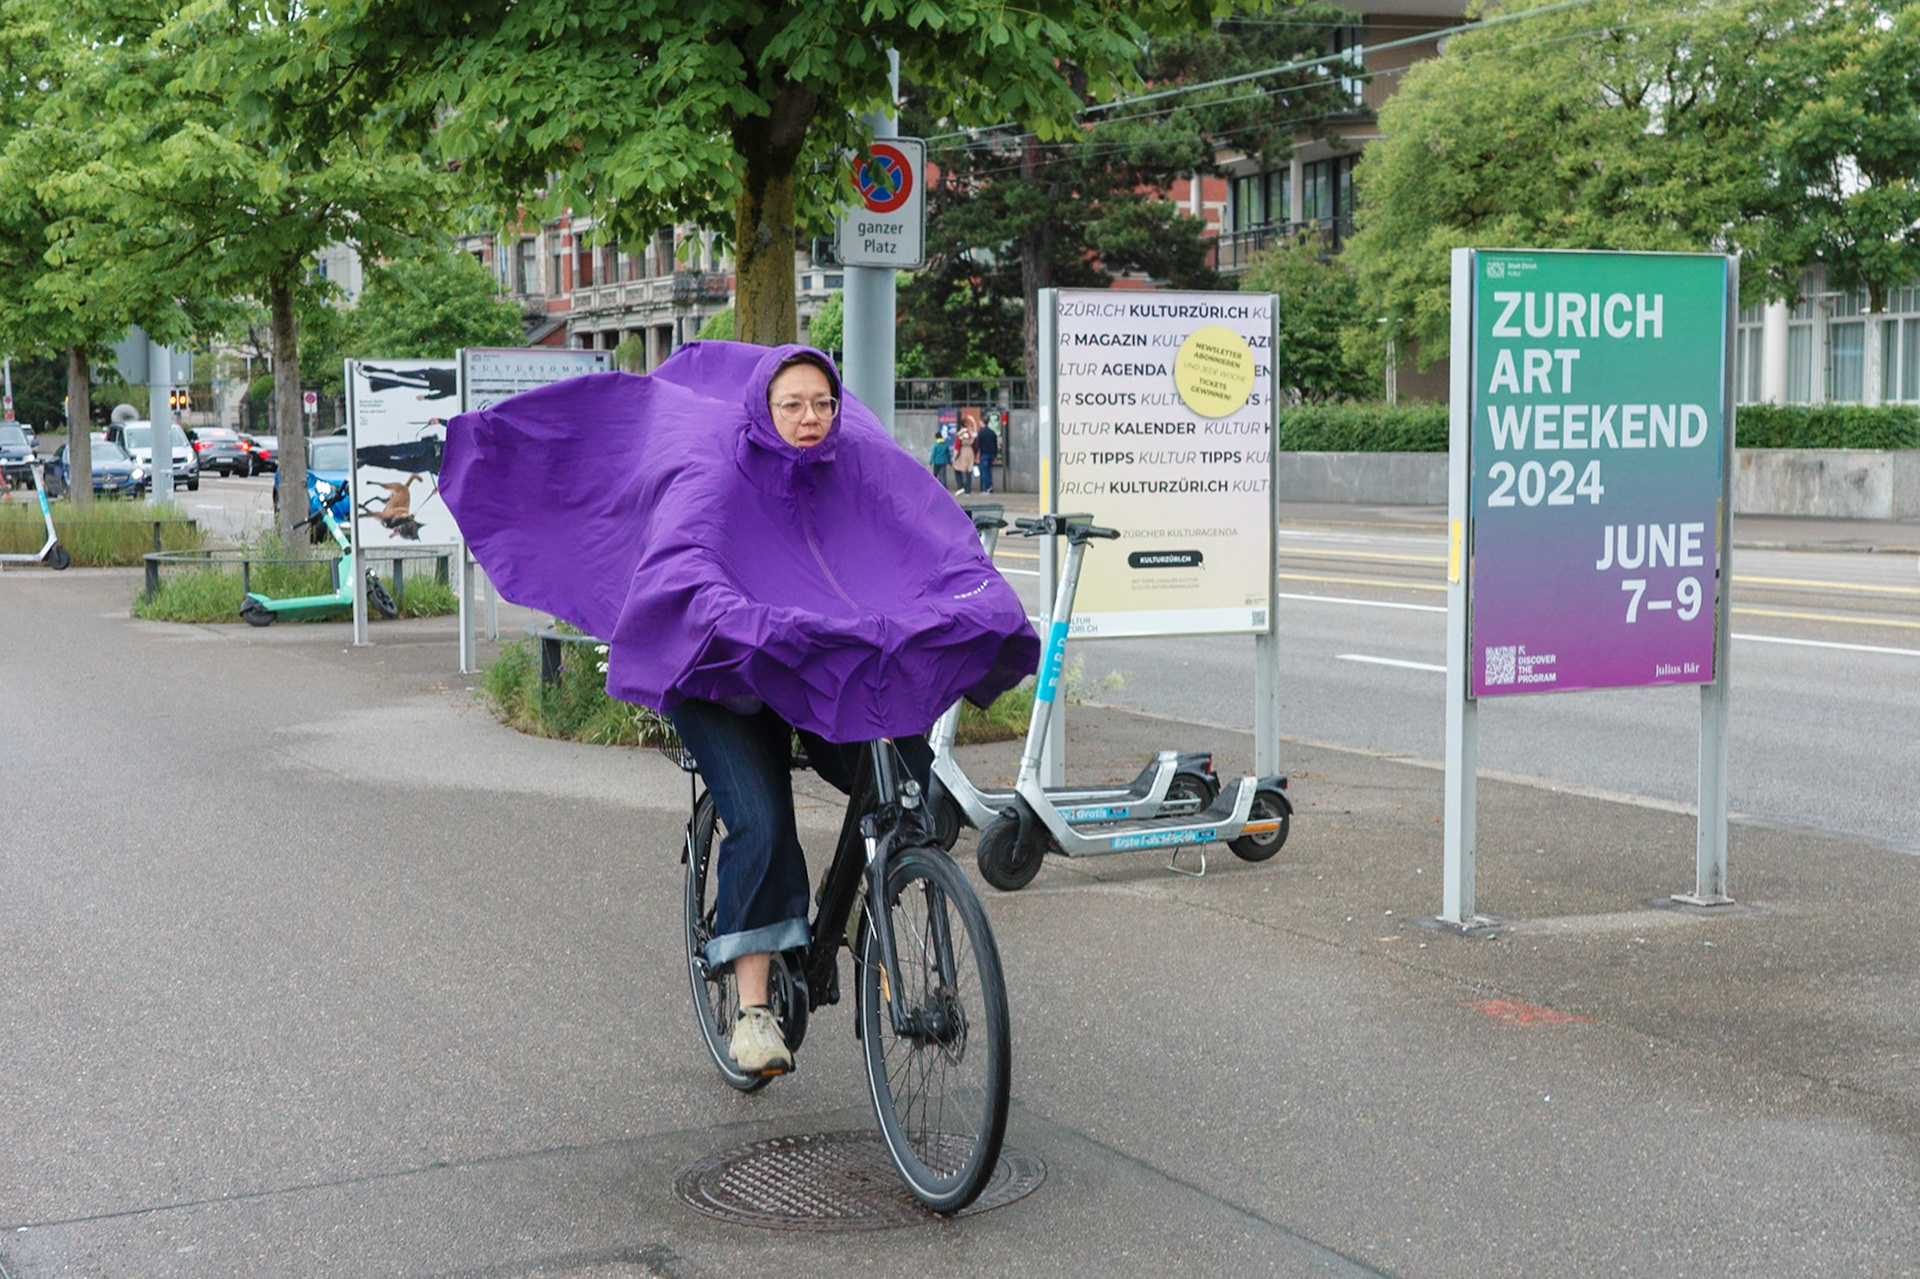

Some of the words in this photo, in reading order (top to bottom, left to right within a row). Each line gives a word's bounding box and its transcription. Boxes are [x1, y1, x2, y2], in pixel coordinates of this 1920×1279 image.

[858, 222, 903, 236] ganzer
[864, 239, 897, 253] Platz
[1129, 303, 1248, 319] KULTURZÜRI.CH
[1491, 291, 1663, 338] ZURICH
[1074, 333, 1147, 347] MAGAZIN
[1241, 335, 1271, 348] AZI
[1196, 342, 1242, 359] NEWSLETTER
[1193, 352, 1241, 369] ABONNIEREN
[1101, 363, 1167, 376] AGENDA
[1488, 349, 1580, 394] ART
[1199, 377, 1227, 391] TICKETS
[1075, 393, 1136, 405] SCOUTS
[1190, 385, 1232, 401] GEWINNEN!
[1059, 422, 1110, 435] ULTUR
[1114, 422, 1196, 435] KALENDER
[1204, 422, 1260, 435] KULTUR
[1487, 404, 1709, 450] WEEKEND
[1090, 452, 1134, 464] TIPPS
[1139, 451, 1196, 464] KULTUR
[1200, 451, 1242, 464] TIPPS
[1110, 477, 1228, 493] KULTURZÜRI.CH
[1488, 460, 1605, 507] 2024
[1122, 528, 1166, 539] ZÜRCHER
[1167, 527, 1238, 538] KULTURAGENDA
[1596, 523, 1704, 570] JUNE
[1139, 554, 1192, 564] KULTURZÜRI.CH
[1518, 654, 1556, 665] DISCOVER
[1518, 665, 1533, 674] THE
[1655, 664, 1682, 677] Julius
[1683, 662, 1700, 674] Bär
[1518, 672, 1557, 683] PROGRAM
